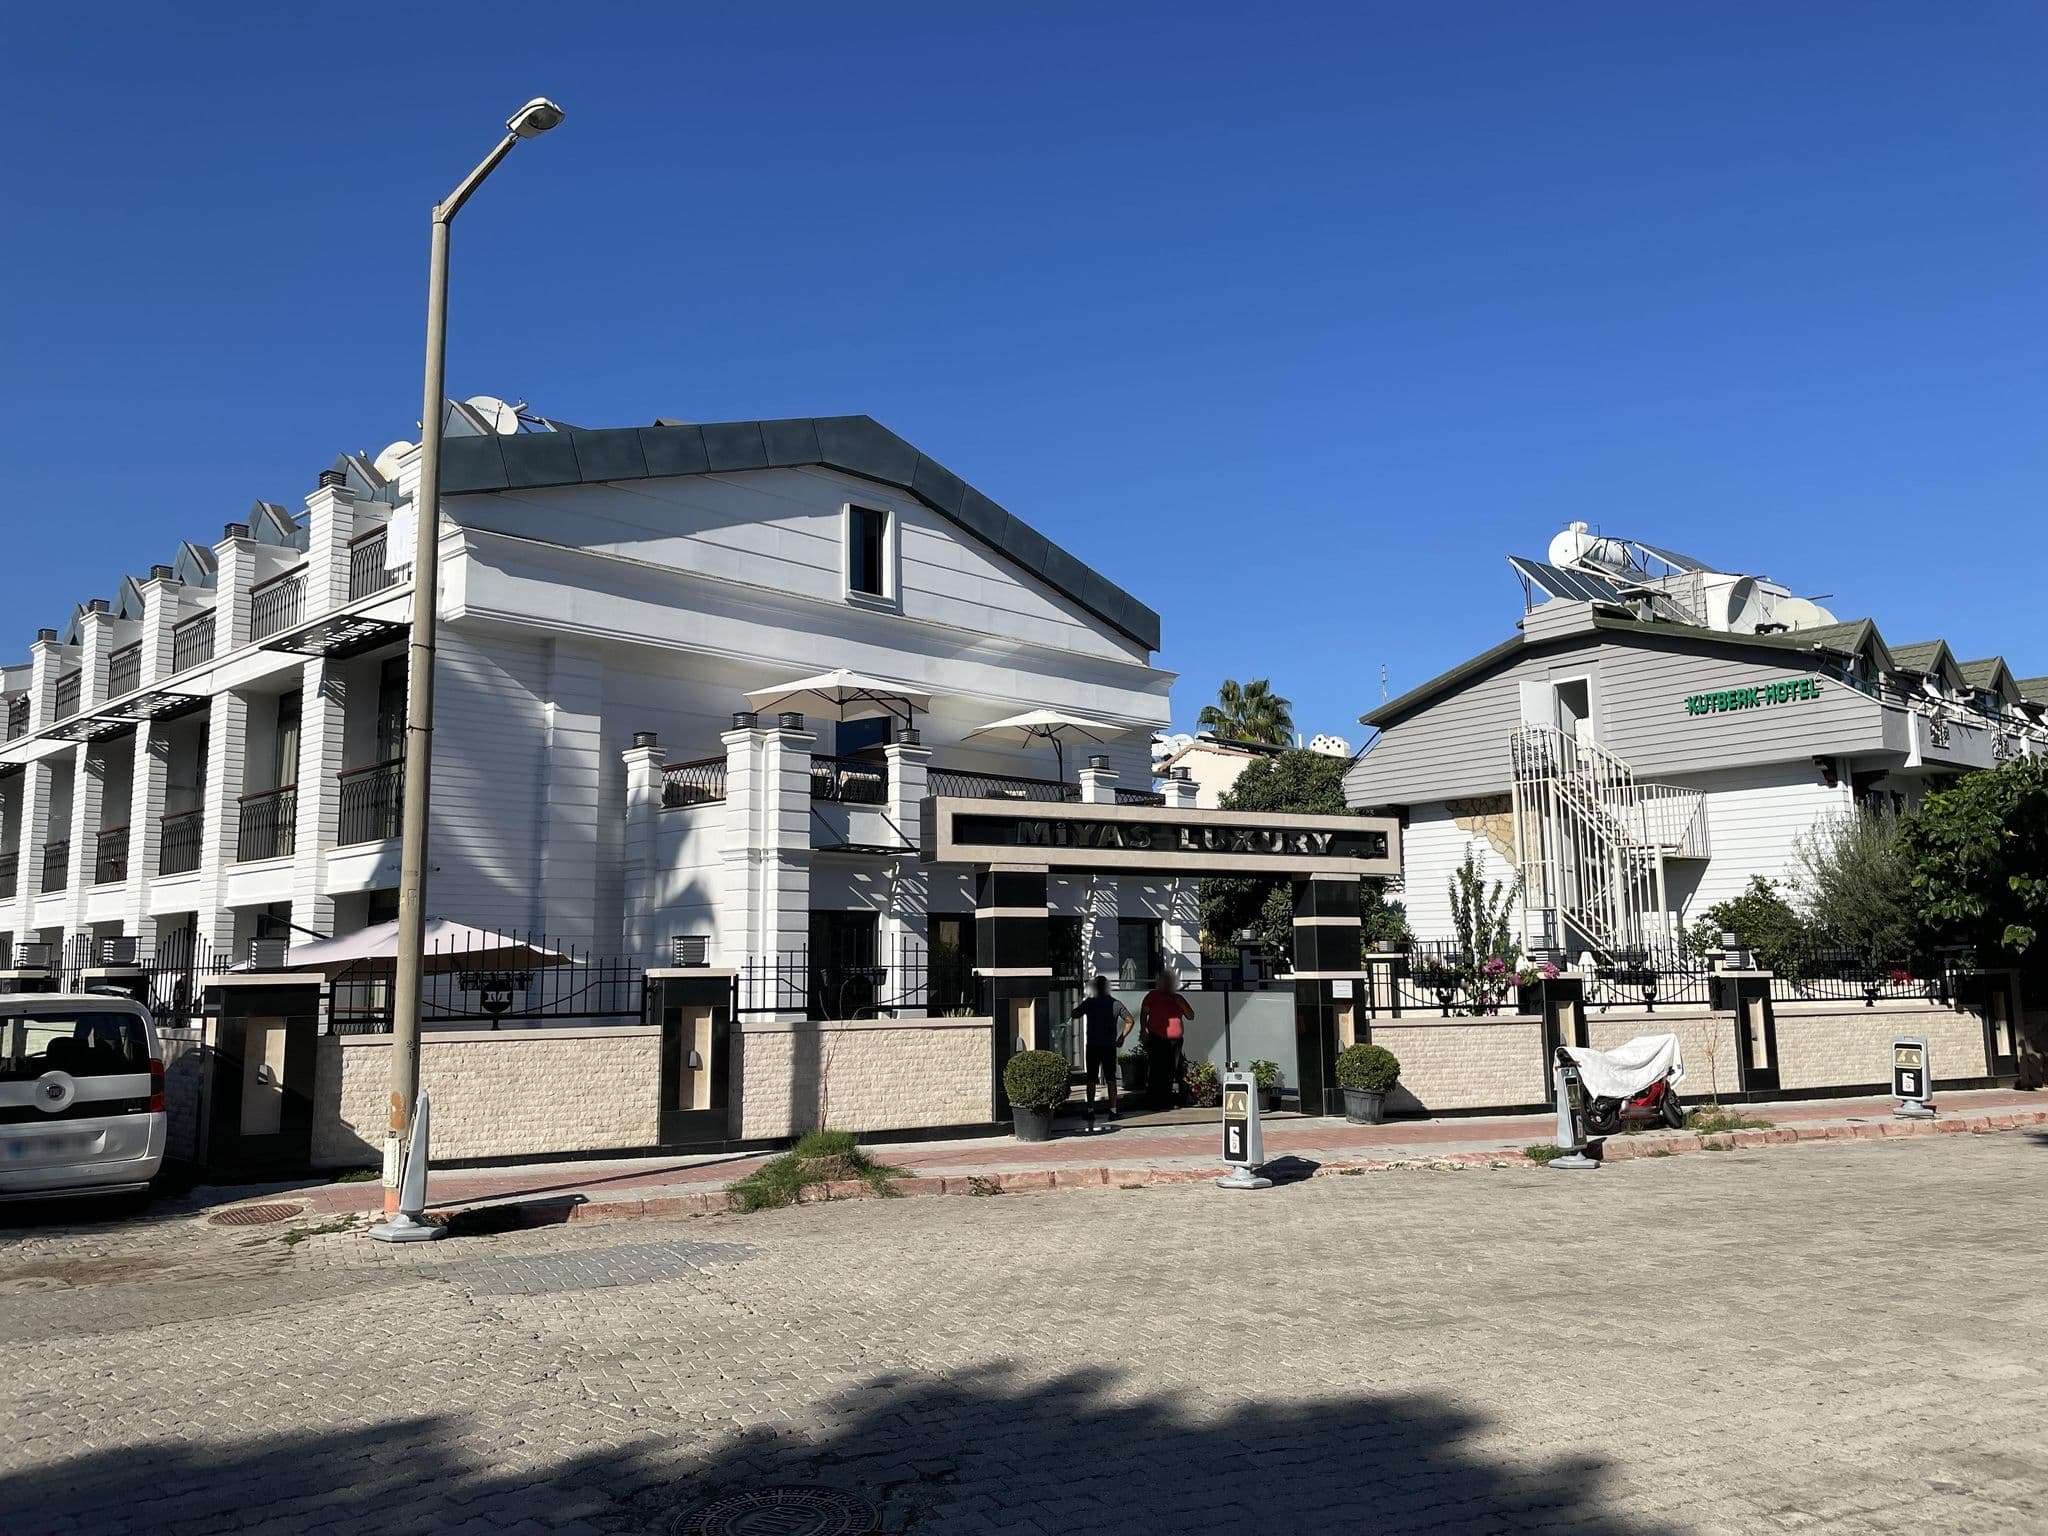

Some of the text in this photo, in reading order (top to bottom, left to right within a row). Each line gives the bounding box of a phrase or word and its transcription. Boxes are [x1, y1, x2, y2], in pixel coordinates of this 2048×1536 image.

[1687, 678, 1820, 715] KUTBERK HOTEL
[1179, 827, 1333, 854] LUXURY
